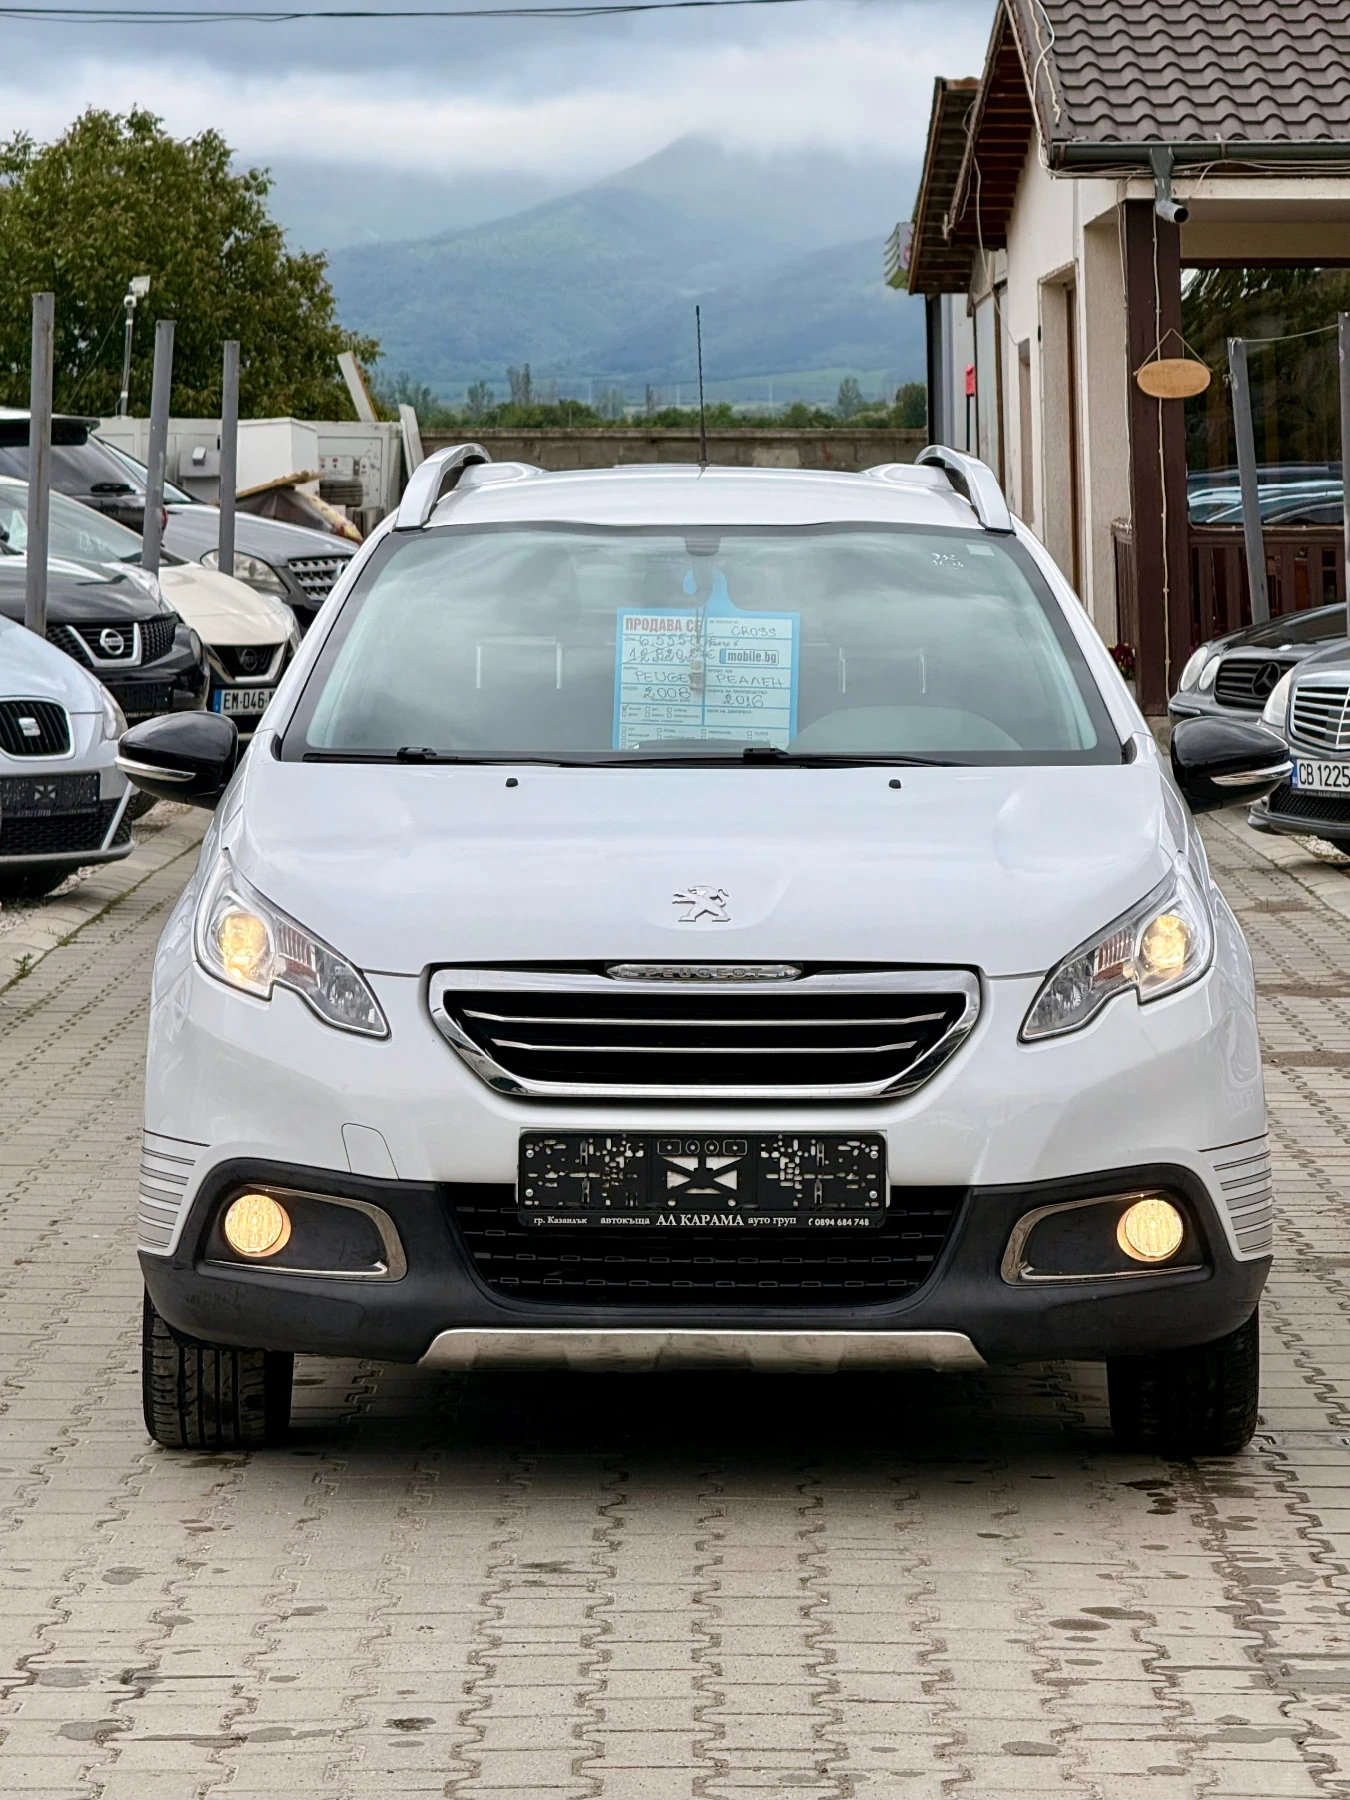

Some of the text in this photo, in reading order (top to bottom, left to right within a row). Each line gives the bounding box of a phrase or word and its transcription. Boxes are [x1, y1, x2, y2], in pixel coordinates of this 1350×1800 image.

[625, 617, 682, 633] ПРОДАВА
[686, 619, 701, 632] СЕ
[731, 625, 777, 637] CROSS
[727, 650, 777, 664] mobile.bg
[635, 670, 690, 683] PEUGE
[716, 673, 783, 688] РЕАЛЕН
[643, 686, 691, 699] 2008
[723, 693, 764, 708] 2016
[1299, 763, 1350, 788] CB 1225
[645, 967, 763, 978] PEUGEOT
[533, 1214, 869, 1227] гр. Казанлък автокъща АЛ КАРАМА ауто груп 0894 684 748
